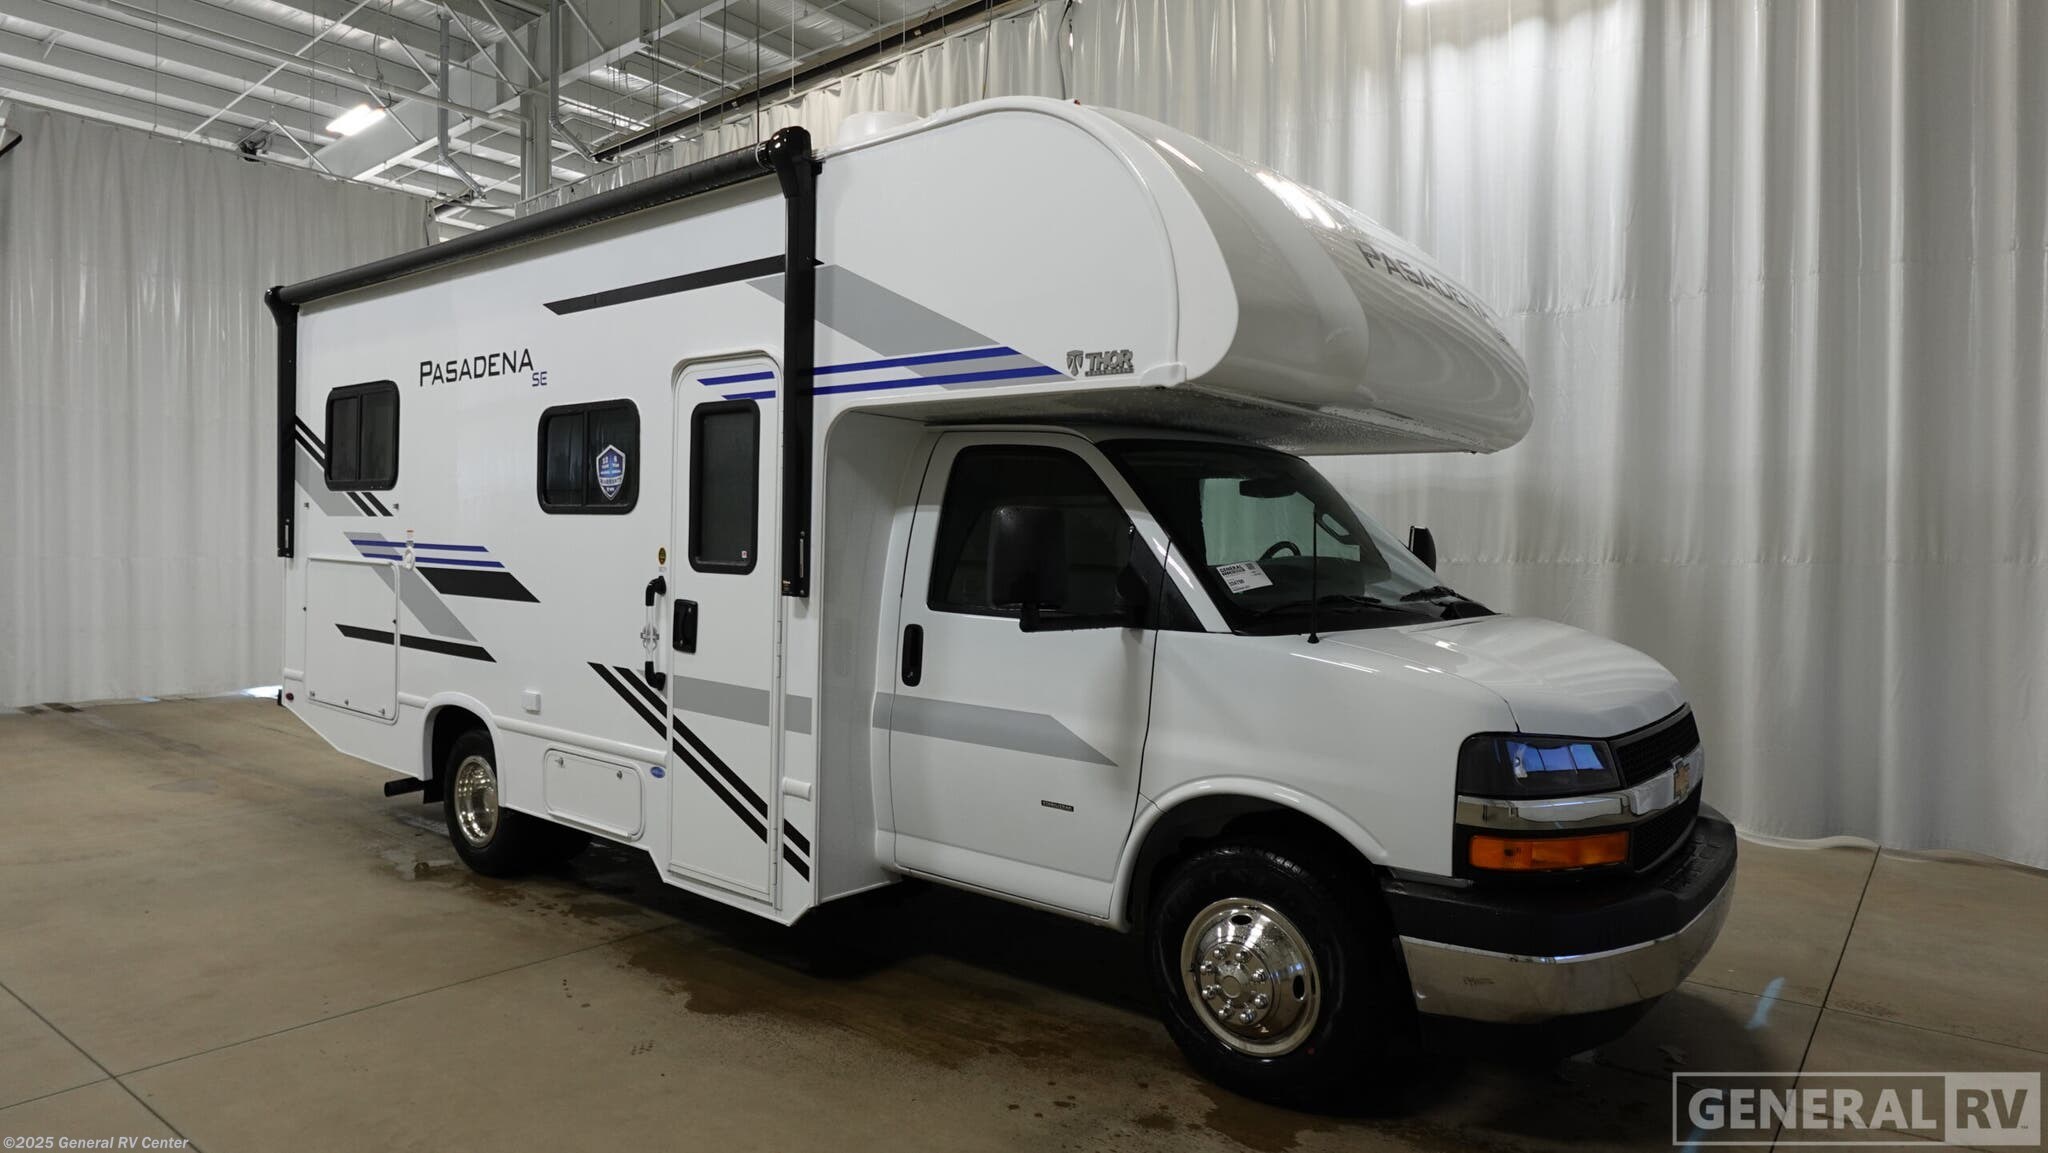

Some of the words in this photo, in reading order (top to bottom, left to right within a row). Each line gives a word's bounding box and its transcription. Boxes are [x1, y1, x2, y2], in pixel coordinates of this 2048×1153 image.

[420, 348, 534, 387] PASADENA
[1085, 349, 1134, 371] THOR
[531, 371, 547, 387] SE
